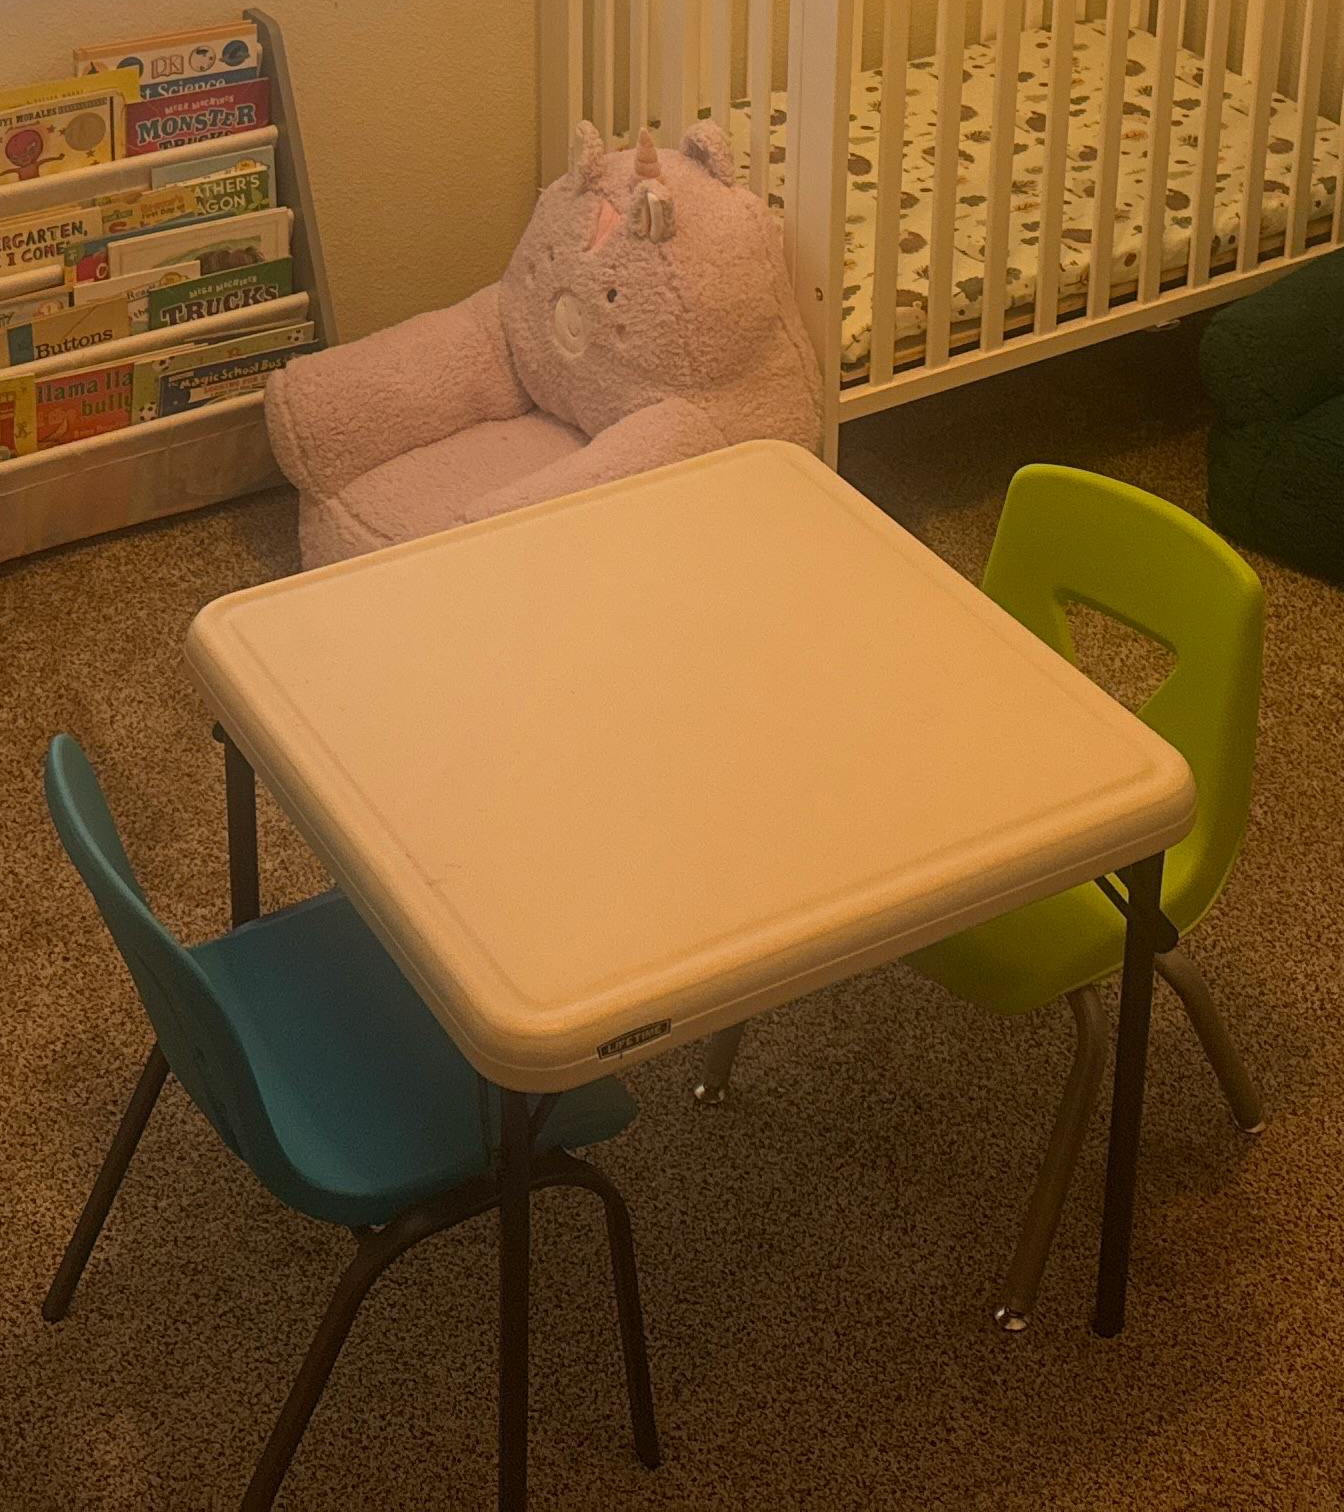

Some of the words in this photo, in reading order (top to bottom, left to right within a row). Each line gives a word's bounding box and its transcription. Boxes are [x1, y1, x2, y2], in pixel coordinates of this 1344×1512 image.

[15, 107, 58, 124] MORALES
[136, 104, 257, 145] MONSTER
[192, 174, 261, 200] ATHER'S
[195, 193, 247, 217] AGON
[7, 251, 16, 265] I
[160, 284, 280, 326] TRUCKS
[35, 328, 113, 360] Buttons
[37, 378, 98, 404] llama
[105, 370, 133, 390] lla
[609, 1024, 663, 1053] LIFETIME
